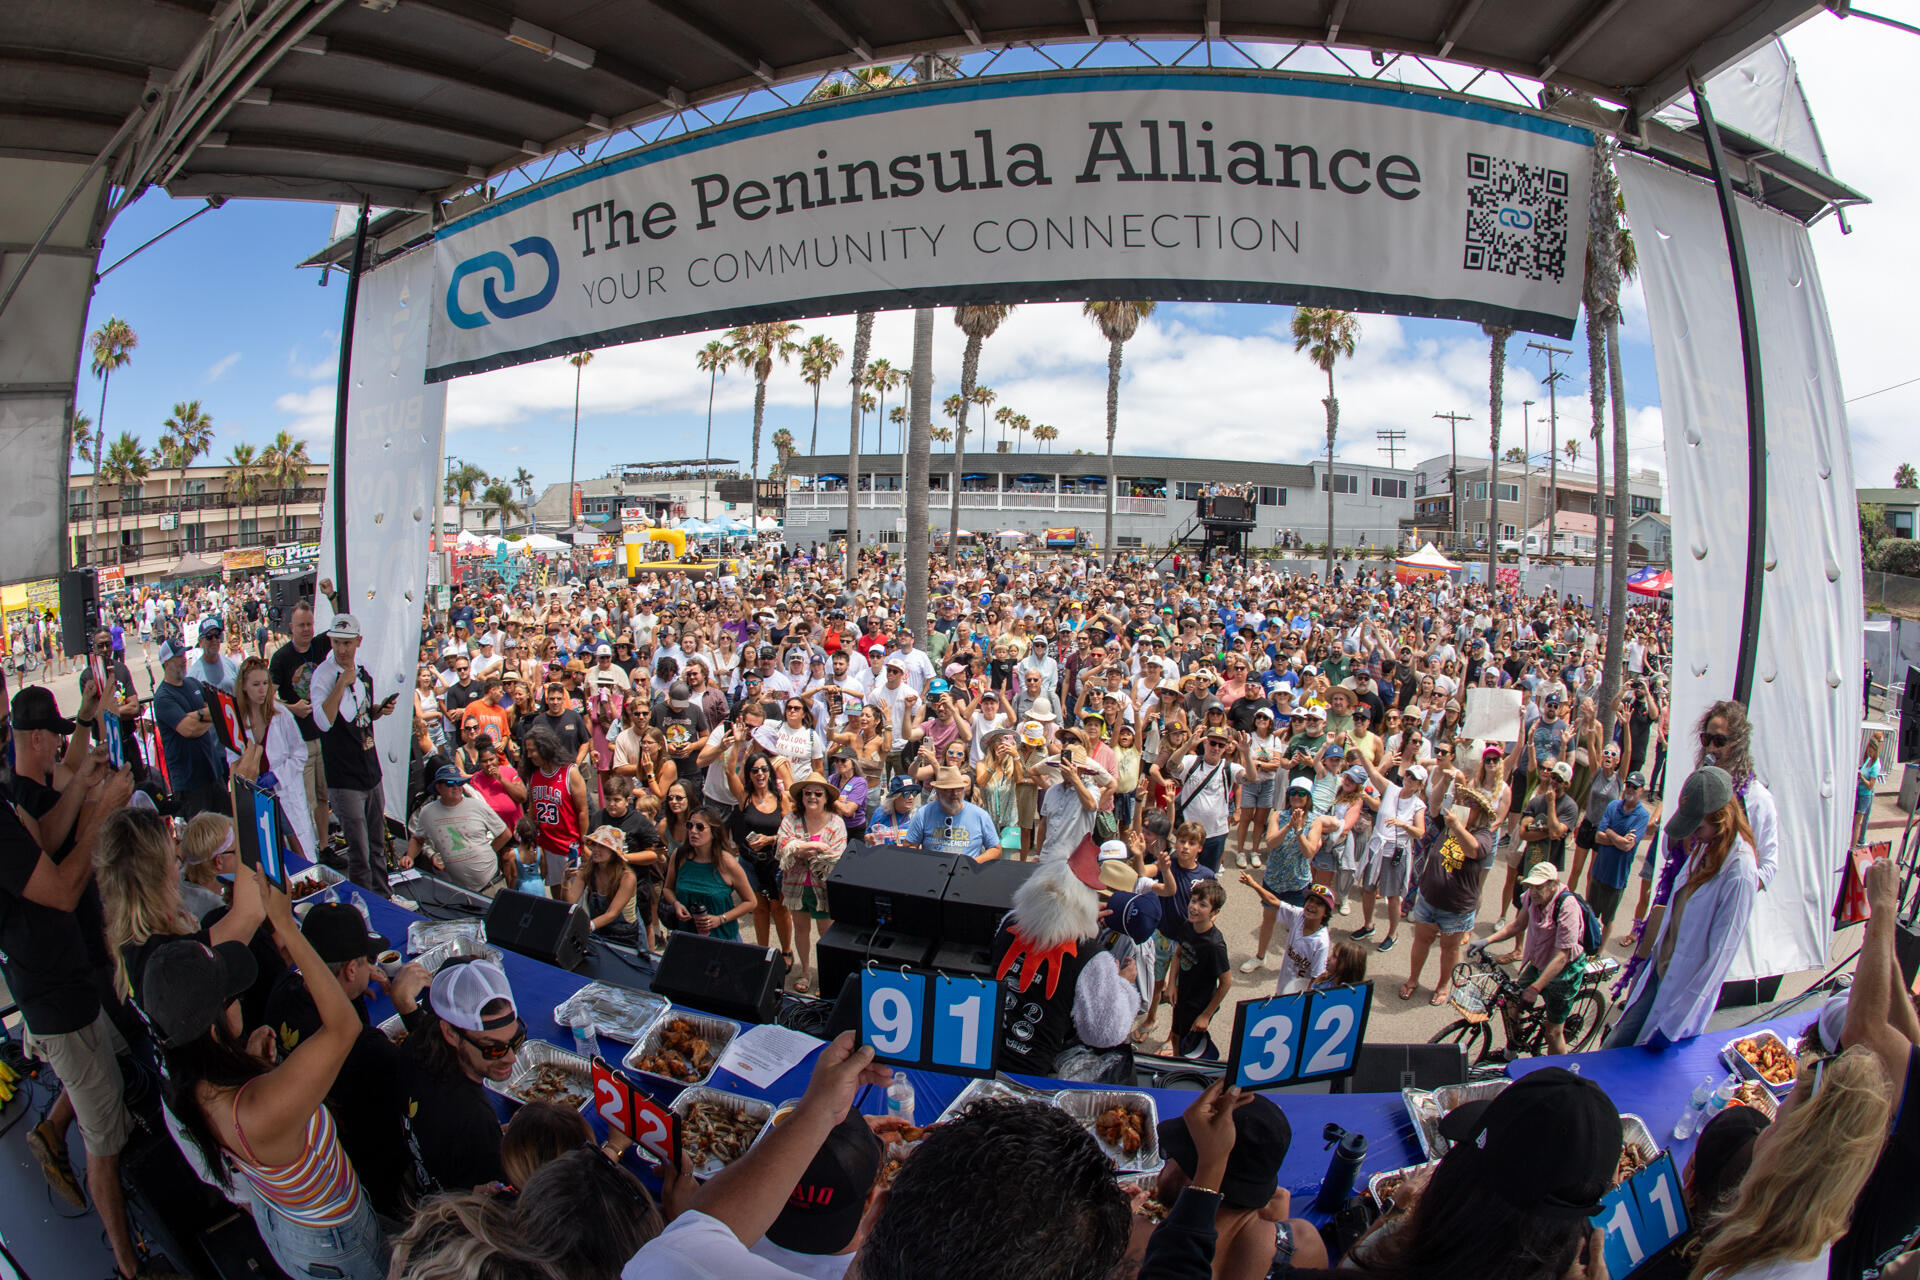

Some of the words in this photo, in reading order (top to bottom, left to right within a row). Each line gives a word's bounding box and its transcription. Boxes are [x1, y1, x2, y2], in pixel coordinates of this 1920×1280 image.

[572, 198, 677, 259] The
[690, 128, 1052, 231] Peninsula
[1075, 119, 1422, 201] Alliance
[582, 266, 667, 309] YOUR
[687, 224, 945, 287] COMMUNITY
[973, 213, 1300, 254] CONNECTION
[258, 810, 277, 877] 1
[536, 802, 559, 825] 23
[868, 987, 981, 1065] 91
[1243, 1004, 1357, 1081] 32
[596, 1077, 669, 1159] 22
[1605, 1171, 1680, 1268] 11
